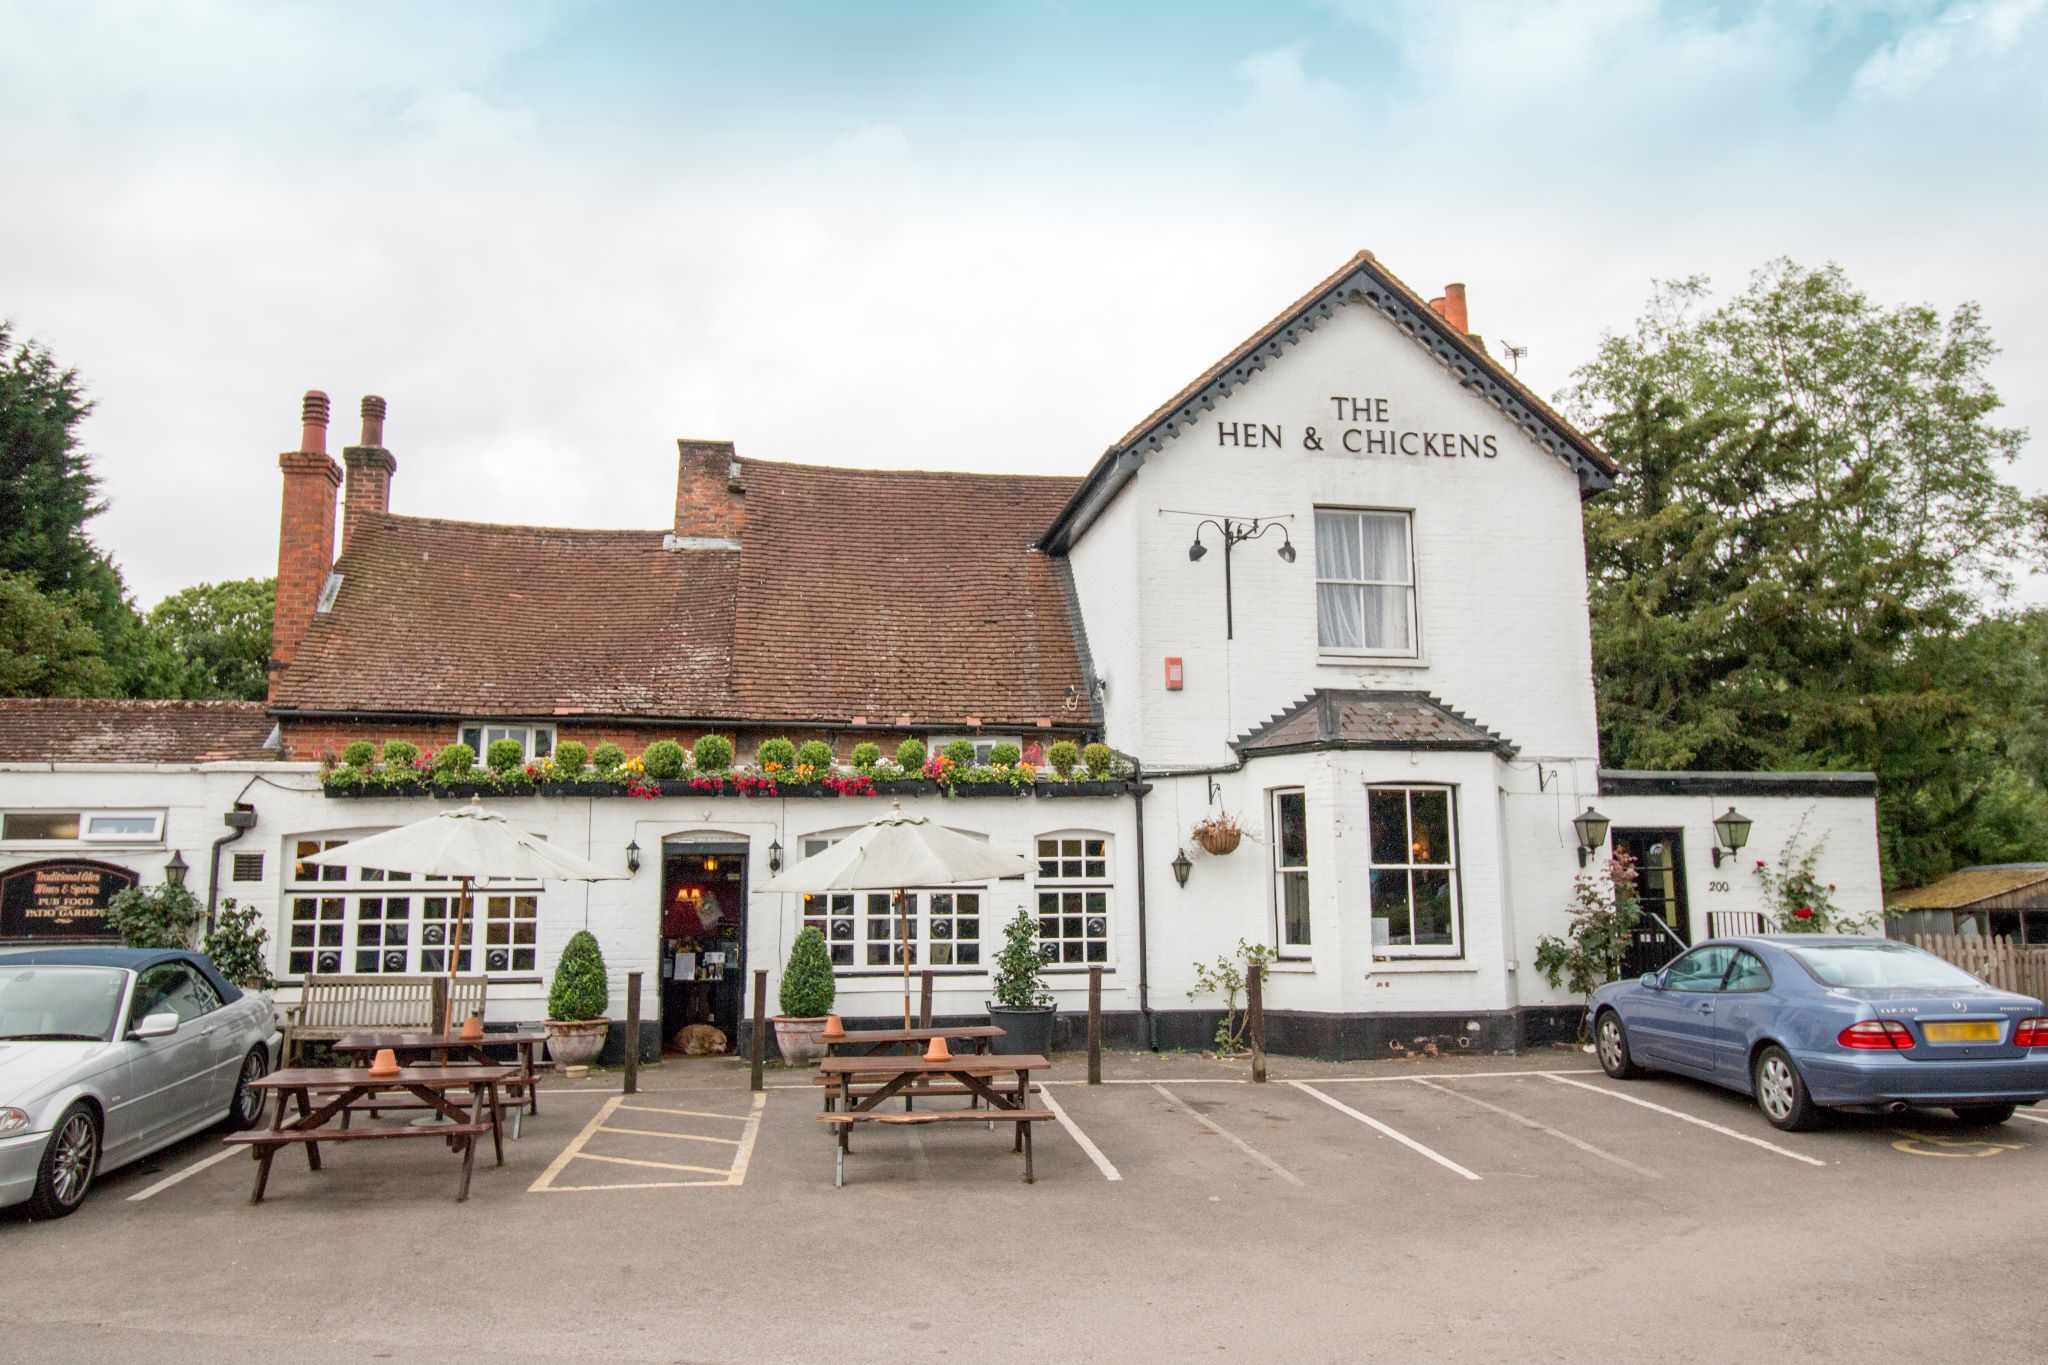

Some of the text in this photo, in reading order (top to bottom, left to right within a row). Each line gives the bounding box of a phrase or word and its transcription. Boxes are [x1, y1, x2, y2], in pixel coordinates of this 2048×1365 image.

[1330, 396, 1390, 423] THE
[1217, 421, 1499, 459] HEN & CHICKENS
[36, 871, 80, 881] Traditional
[61, 884, 69, 894] &
[70, 884, 99, 896] Spirits
[1709, 881, 1729, 892] 200
[38, 898, 94, 906] PUB FOOD
[25, 909, 56, 917] PATIO
